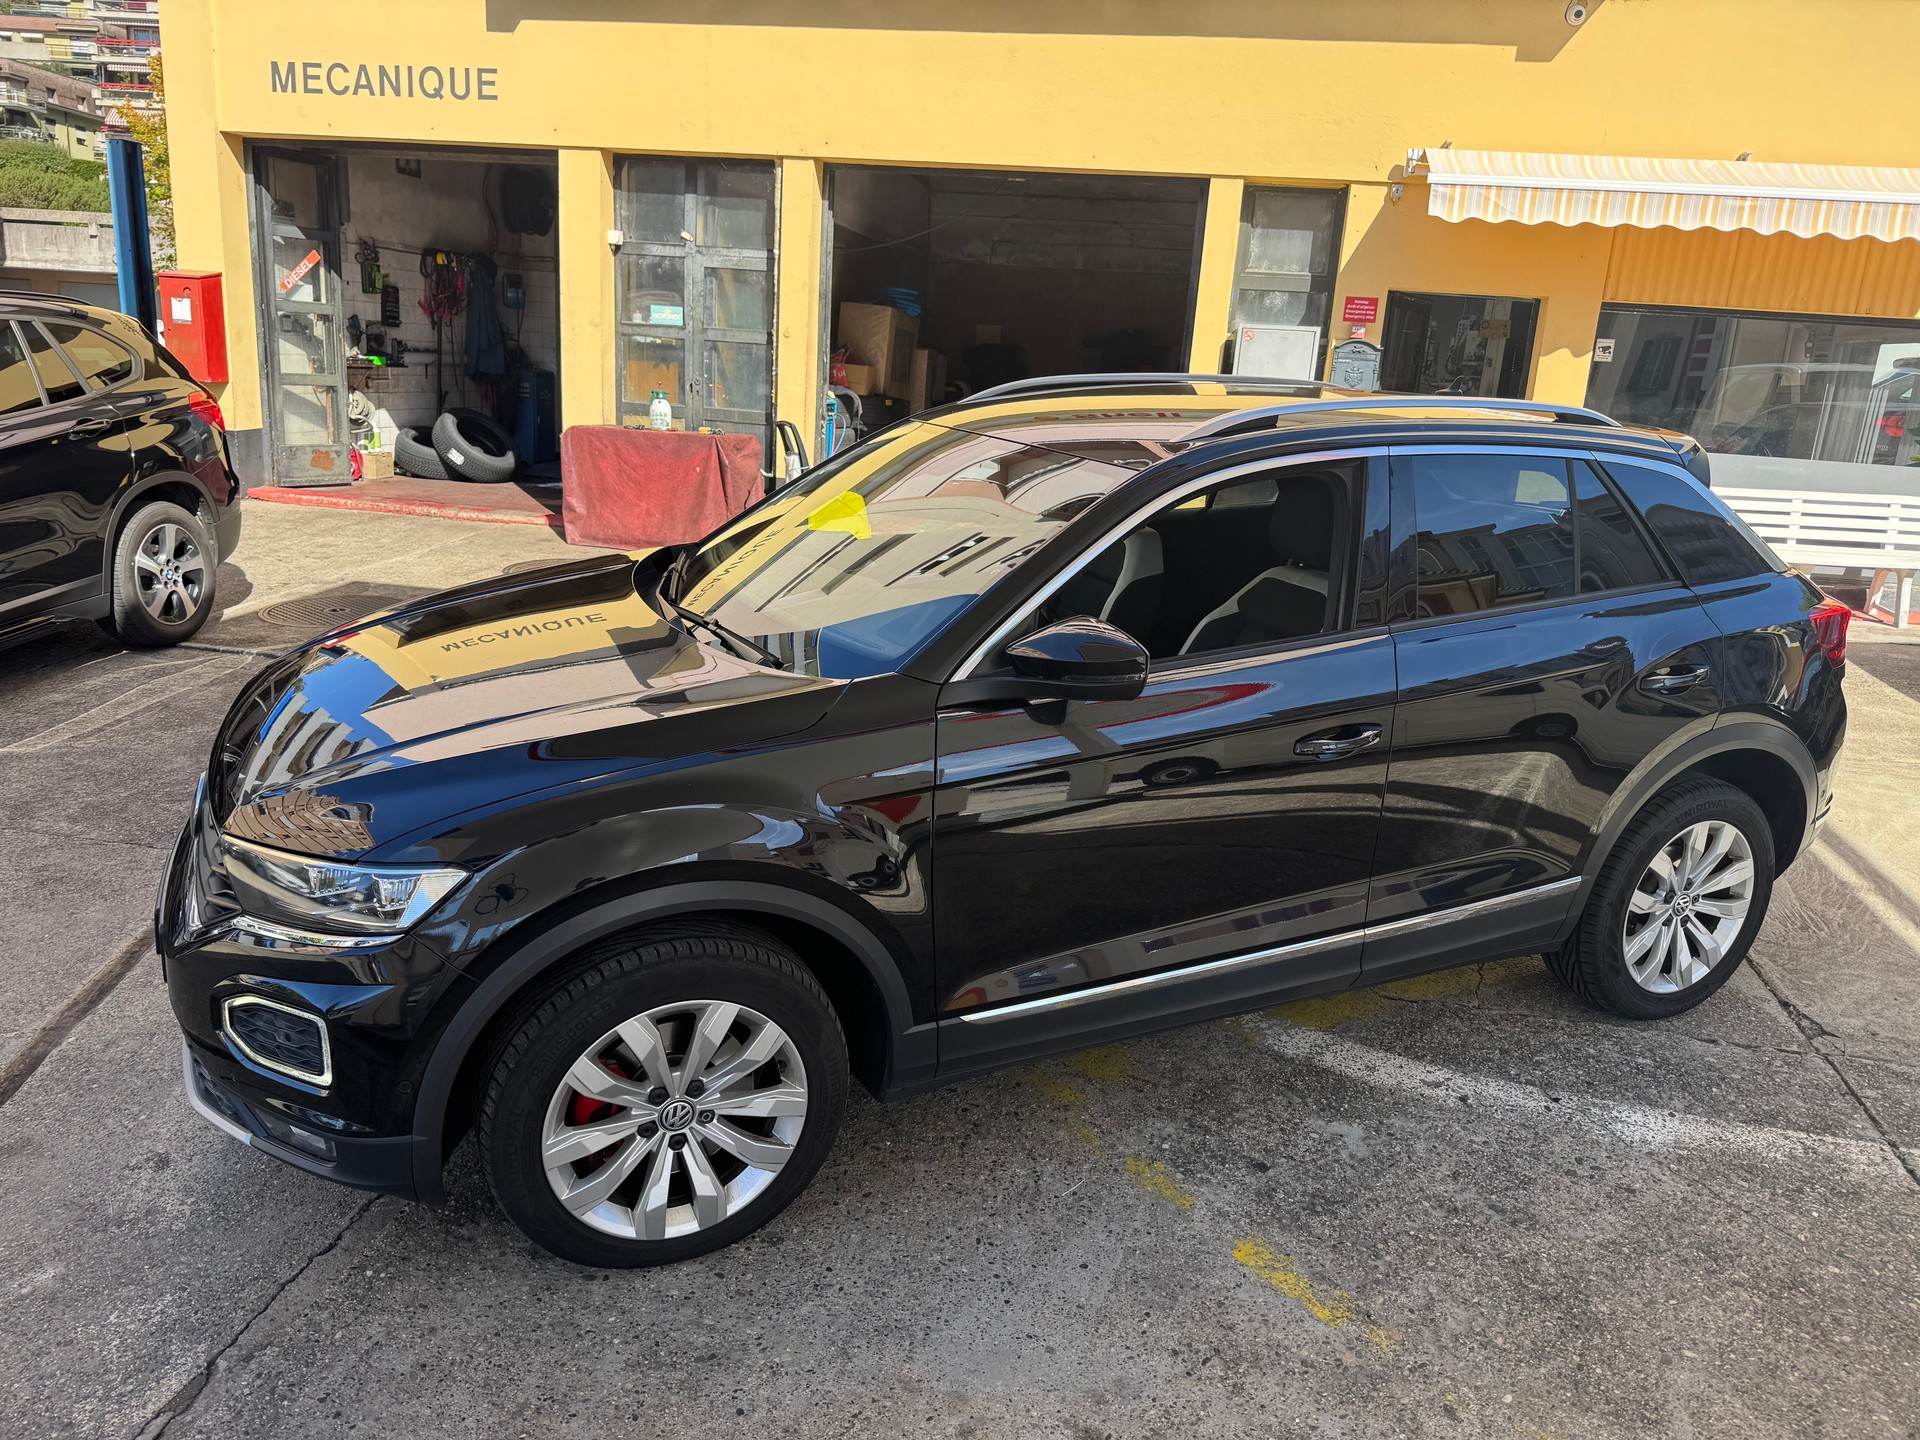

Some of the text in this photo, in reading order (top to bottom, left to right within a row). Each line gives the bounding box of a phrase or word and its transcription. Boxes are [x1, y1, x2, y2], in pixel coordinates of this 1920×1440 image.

[271, 61, 498, 100] MECANIQUE
[283, 260, 313, 288] DIESEL
[1675, 799, 1729, 825] UNIROYAL
[532, 1010, 597, 1078] RainSport
